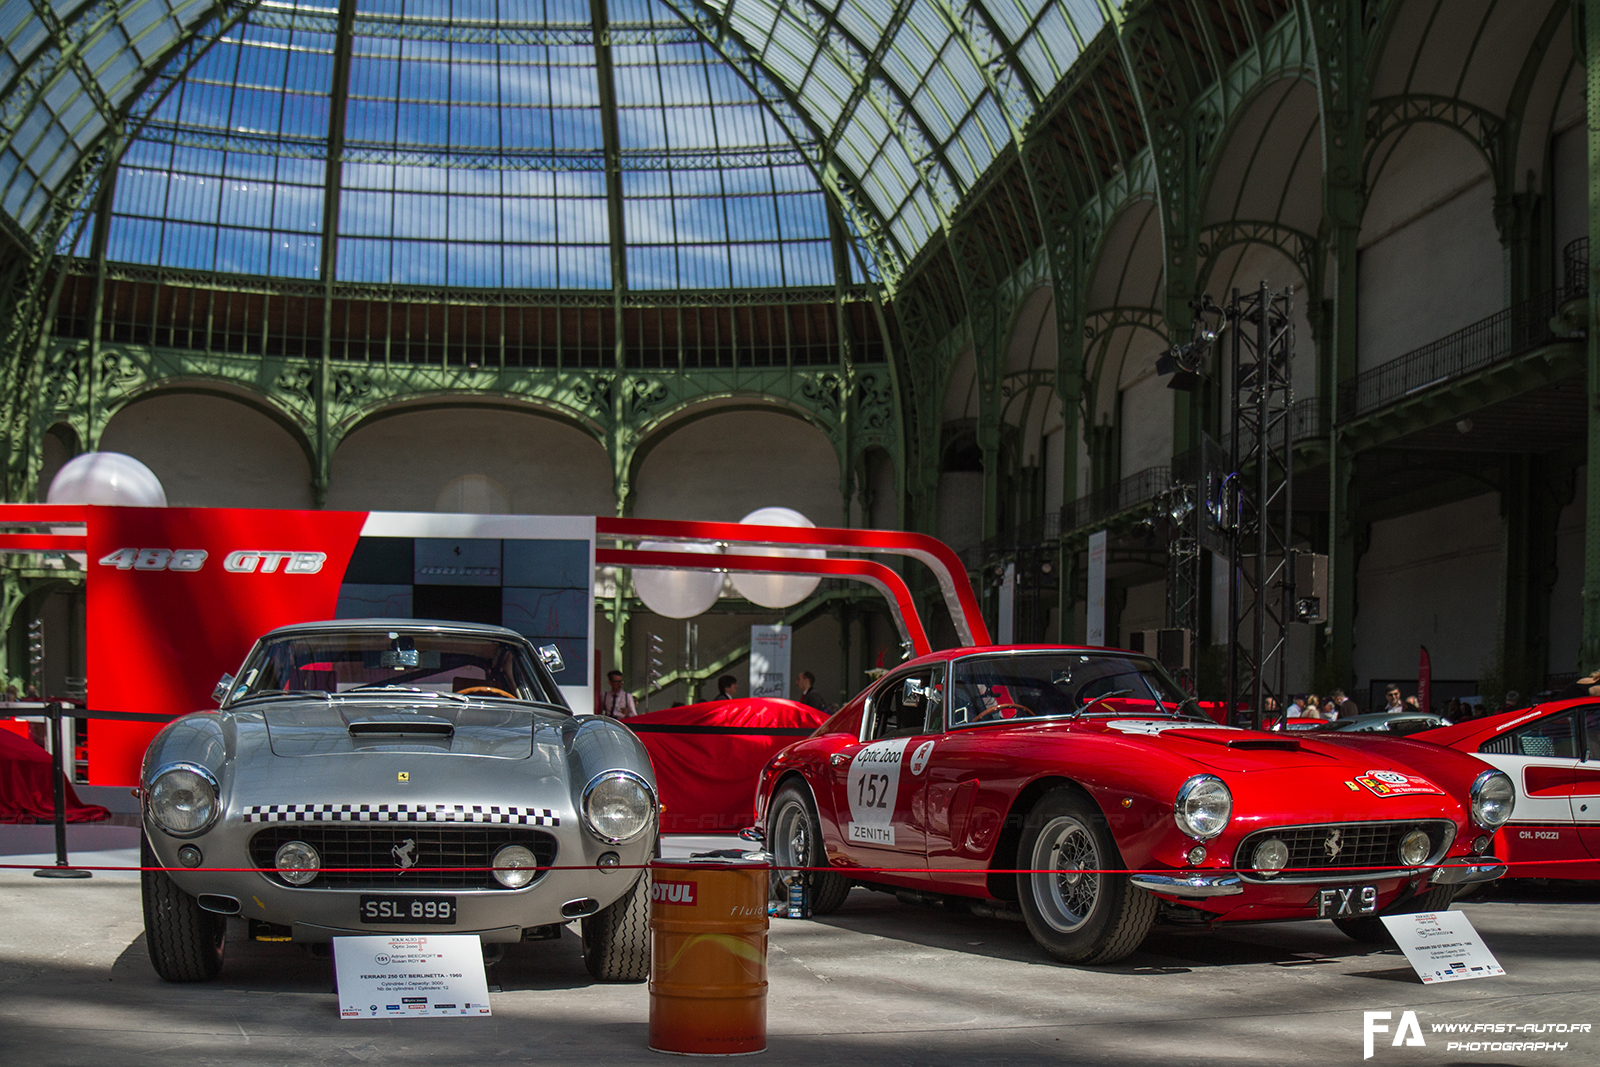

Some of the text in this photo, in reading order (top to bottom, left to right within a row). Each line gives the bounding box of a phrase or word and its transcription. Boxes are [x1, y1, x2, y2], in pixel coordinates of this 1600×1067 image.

[98, 548, 327, 574] 488 GTB
[858, 748, 901, 767] Optic 2000
[858, 774, 889, 808] 152
[854, 826, 890, 841] ZENITH
[1519, 831, 1534, 839] CH.
[651, 882, 693, 902] OTUL
[1320, 886, 1377, 917] FX 9
[366, 901, 450, 918] SSL 899
